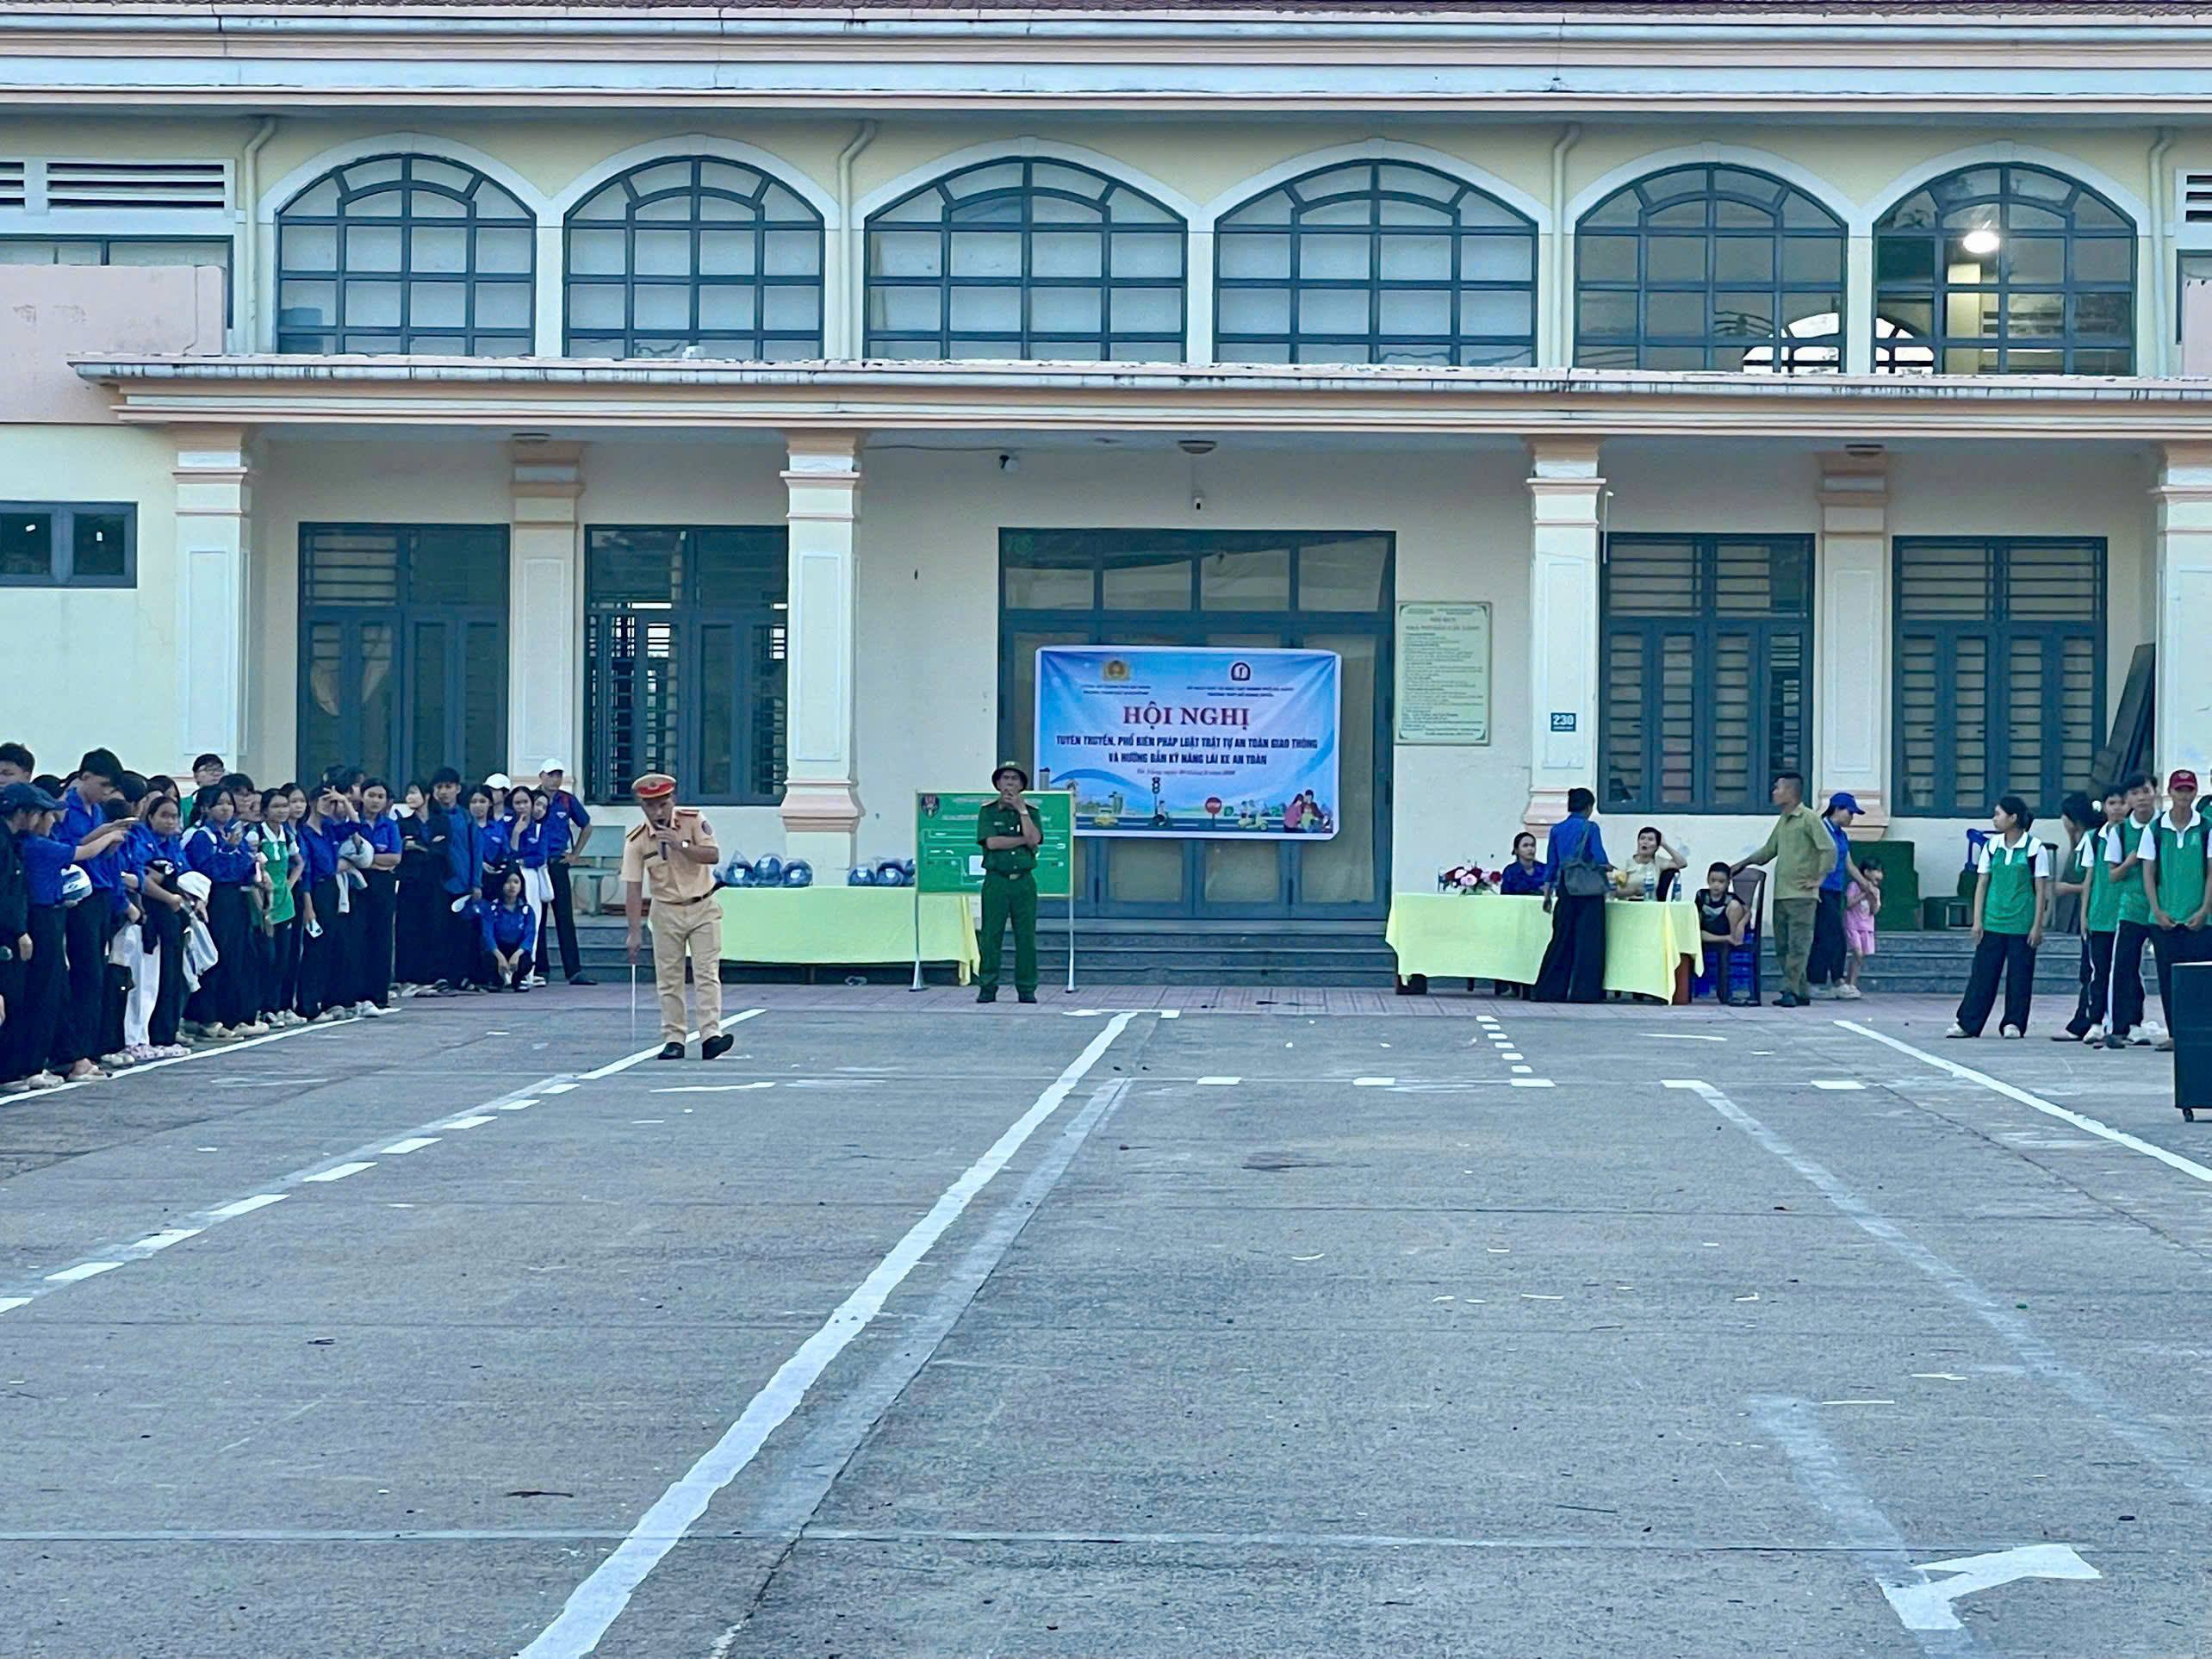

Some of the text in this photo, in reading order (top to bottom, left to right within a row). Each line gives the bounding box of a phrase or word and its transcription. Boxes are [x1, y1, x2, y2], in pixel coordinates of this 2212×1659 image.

[1123, 700, 1250, 730] HỘI NGHỊ
[1552, 714, 1575, 725] 230
[1234, 738, 1246, 748] AN
[1221, 755, 1231, 764] XE
[1233, 755, 1244, 764] AN
